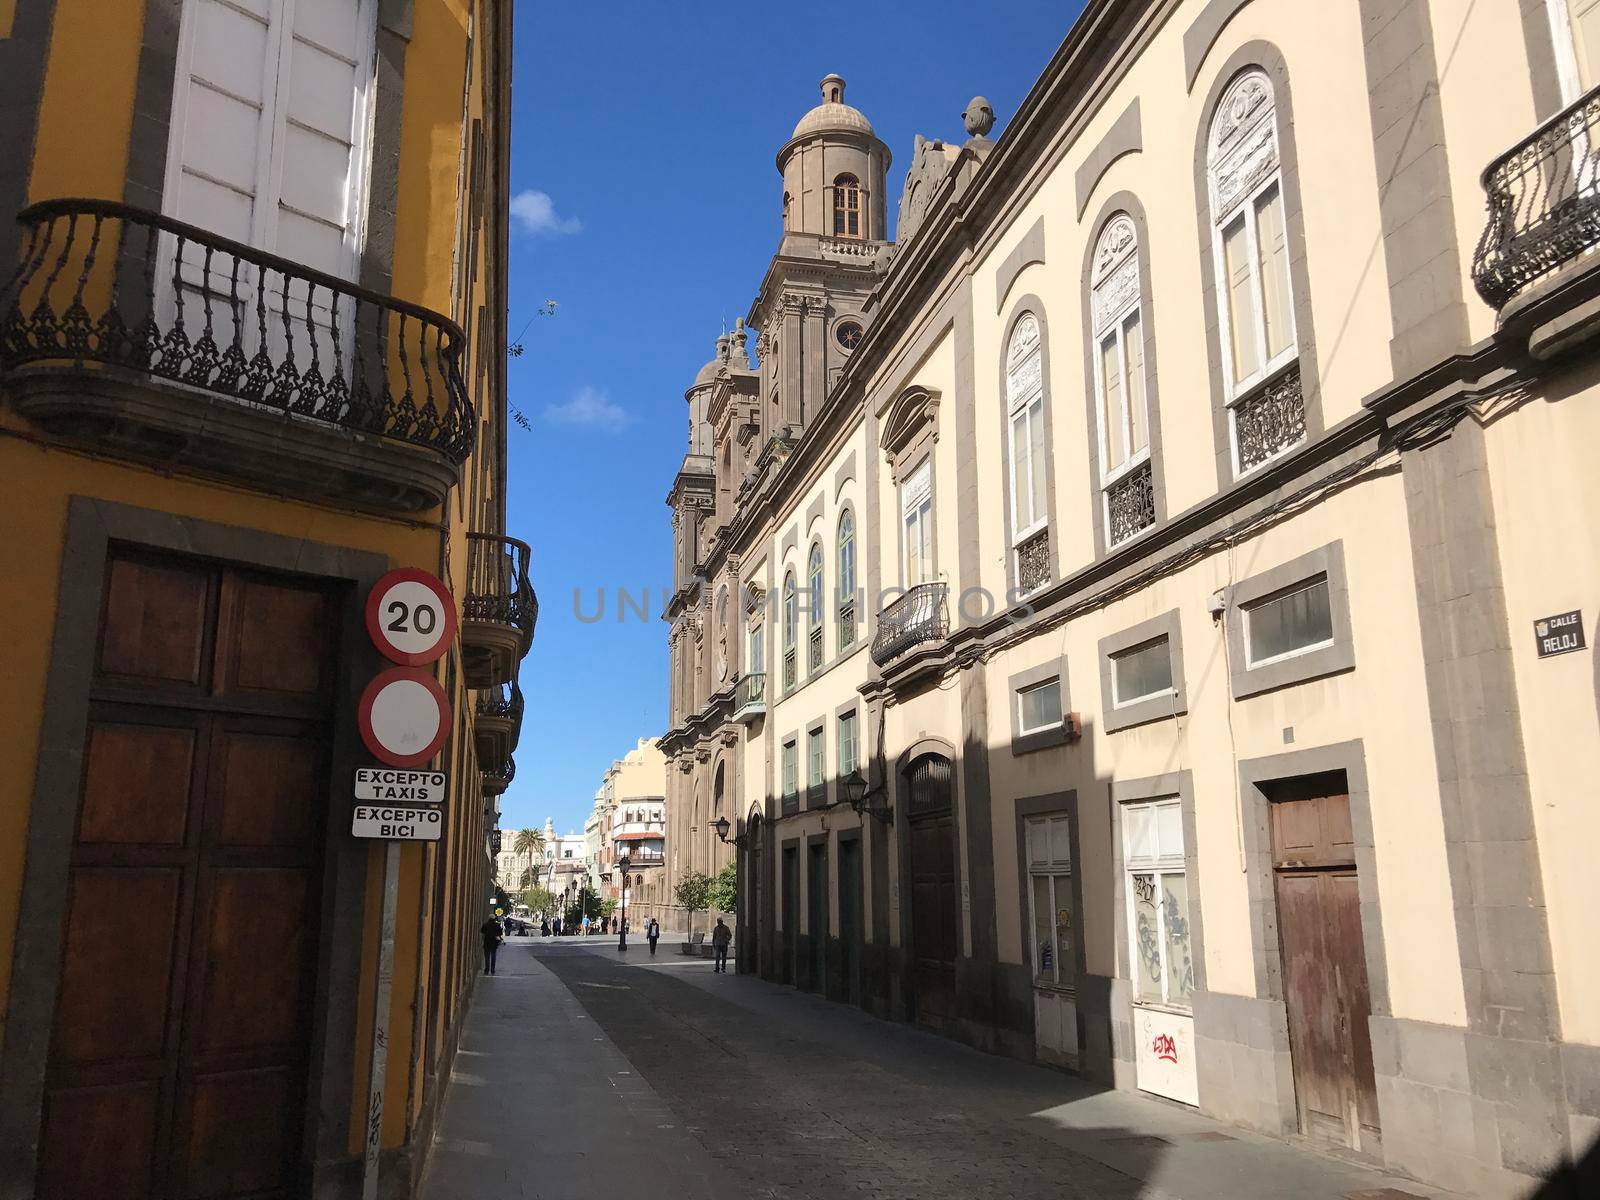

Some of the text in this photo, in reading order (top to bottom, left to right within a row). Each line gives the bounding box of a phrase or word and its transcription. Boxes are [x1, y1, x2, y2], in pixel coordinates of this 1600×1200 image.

[387, 600, 437, 635] 20
[1550, 614, 1577, 629] CALLE
[1543, 633, 1578, 653] RELOJ
[357, 770, 444, 787] EXCEPTO
[372, 785, 429, 800] TAXIS
[355, 807, 440, 823] EXCEPTO
[380, 823, 415, 838] BICI
